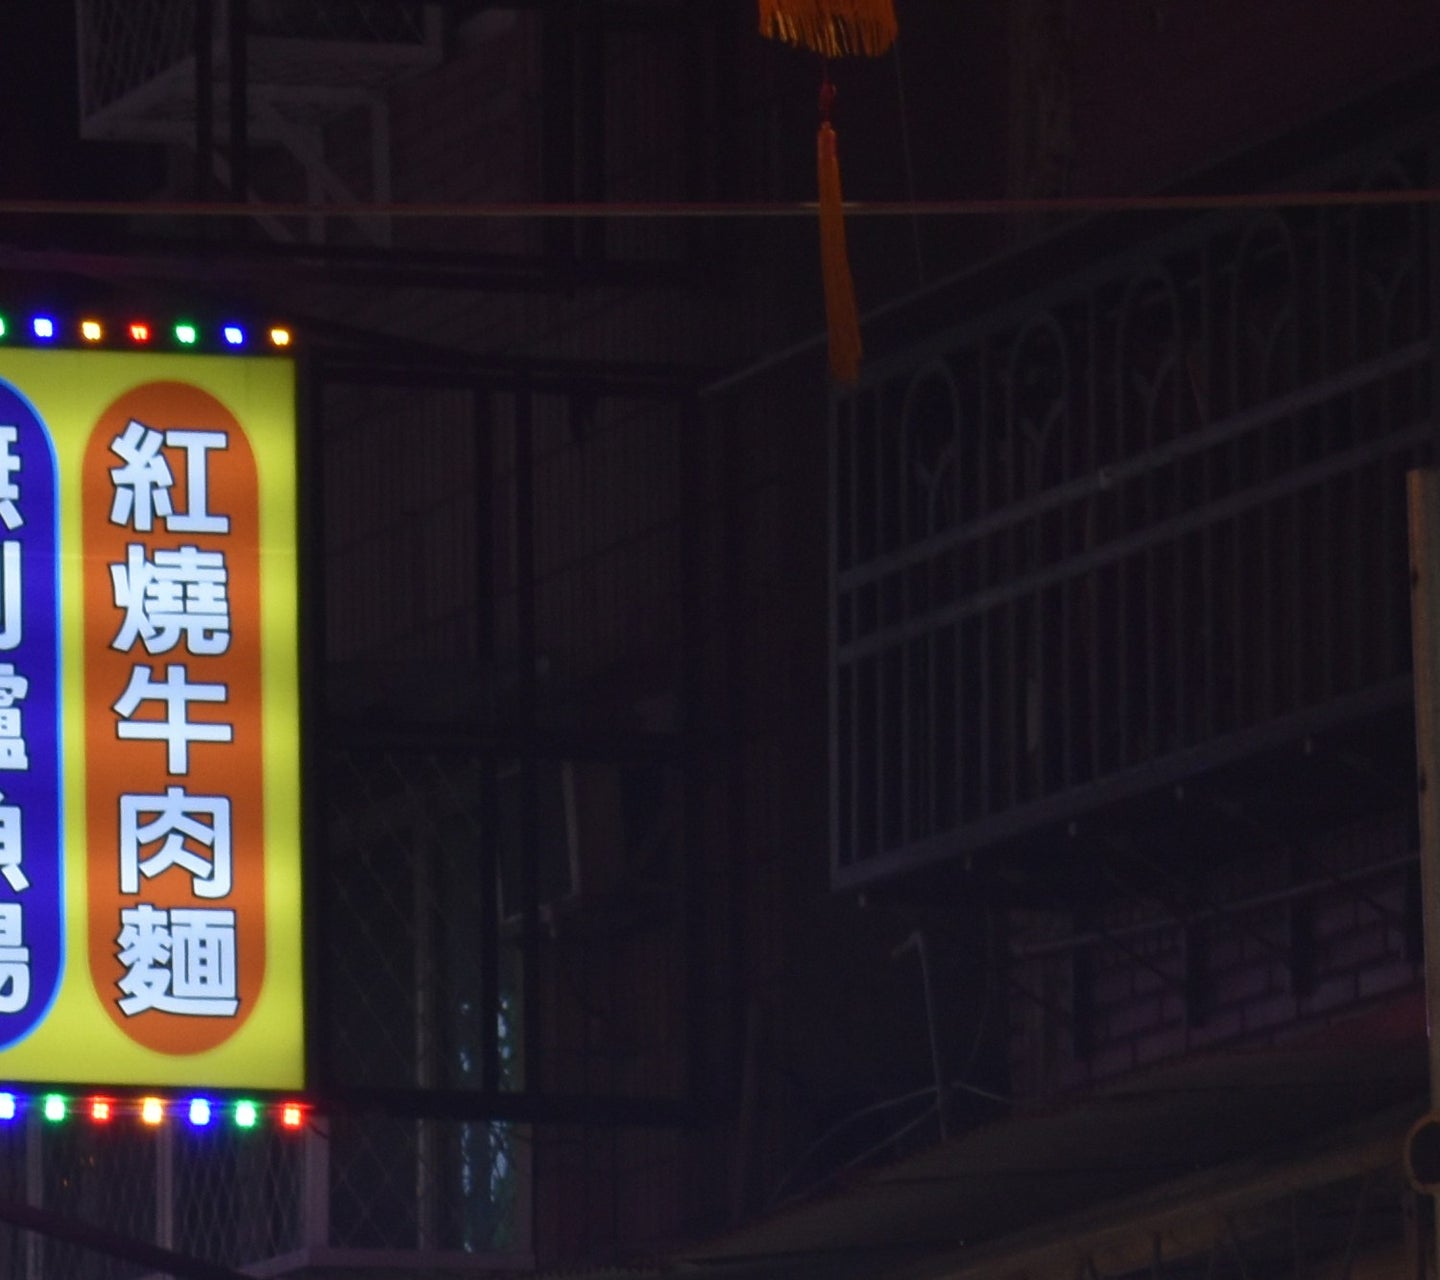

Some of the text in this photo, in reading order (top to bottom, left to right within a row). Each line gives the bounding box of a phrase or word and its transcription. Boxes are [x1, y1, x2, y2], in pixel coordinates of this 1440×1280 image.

[108, 419, 239, 1020] 紅燒牛肉麵
